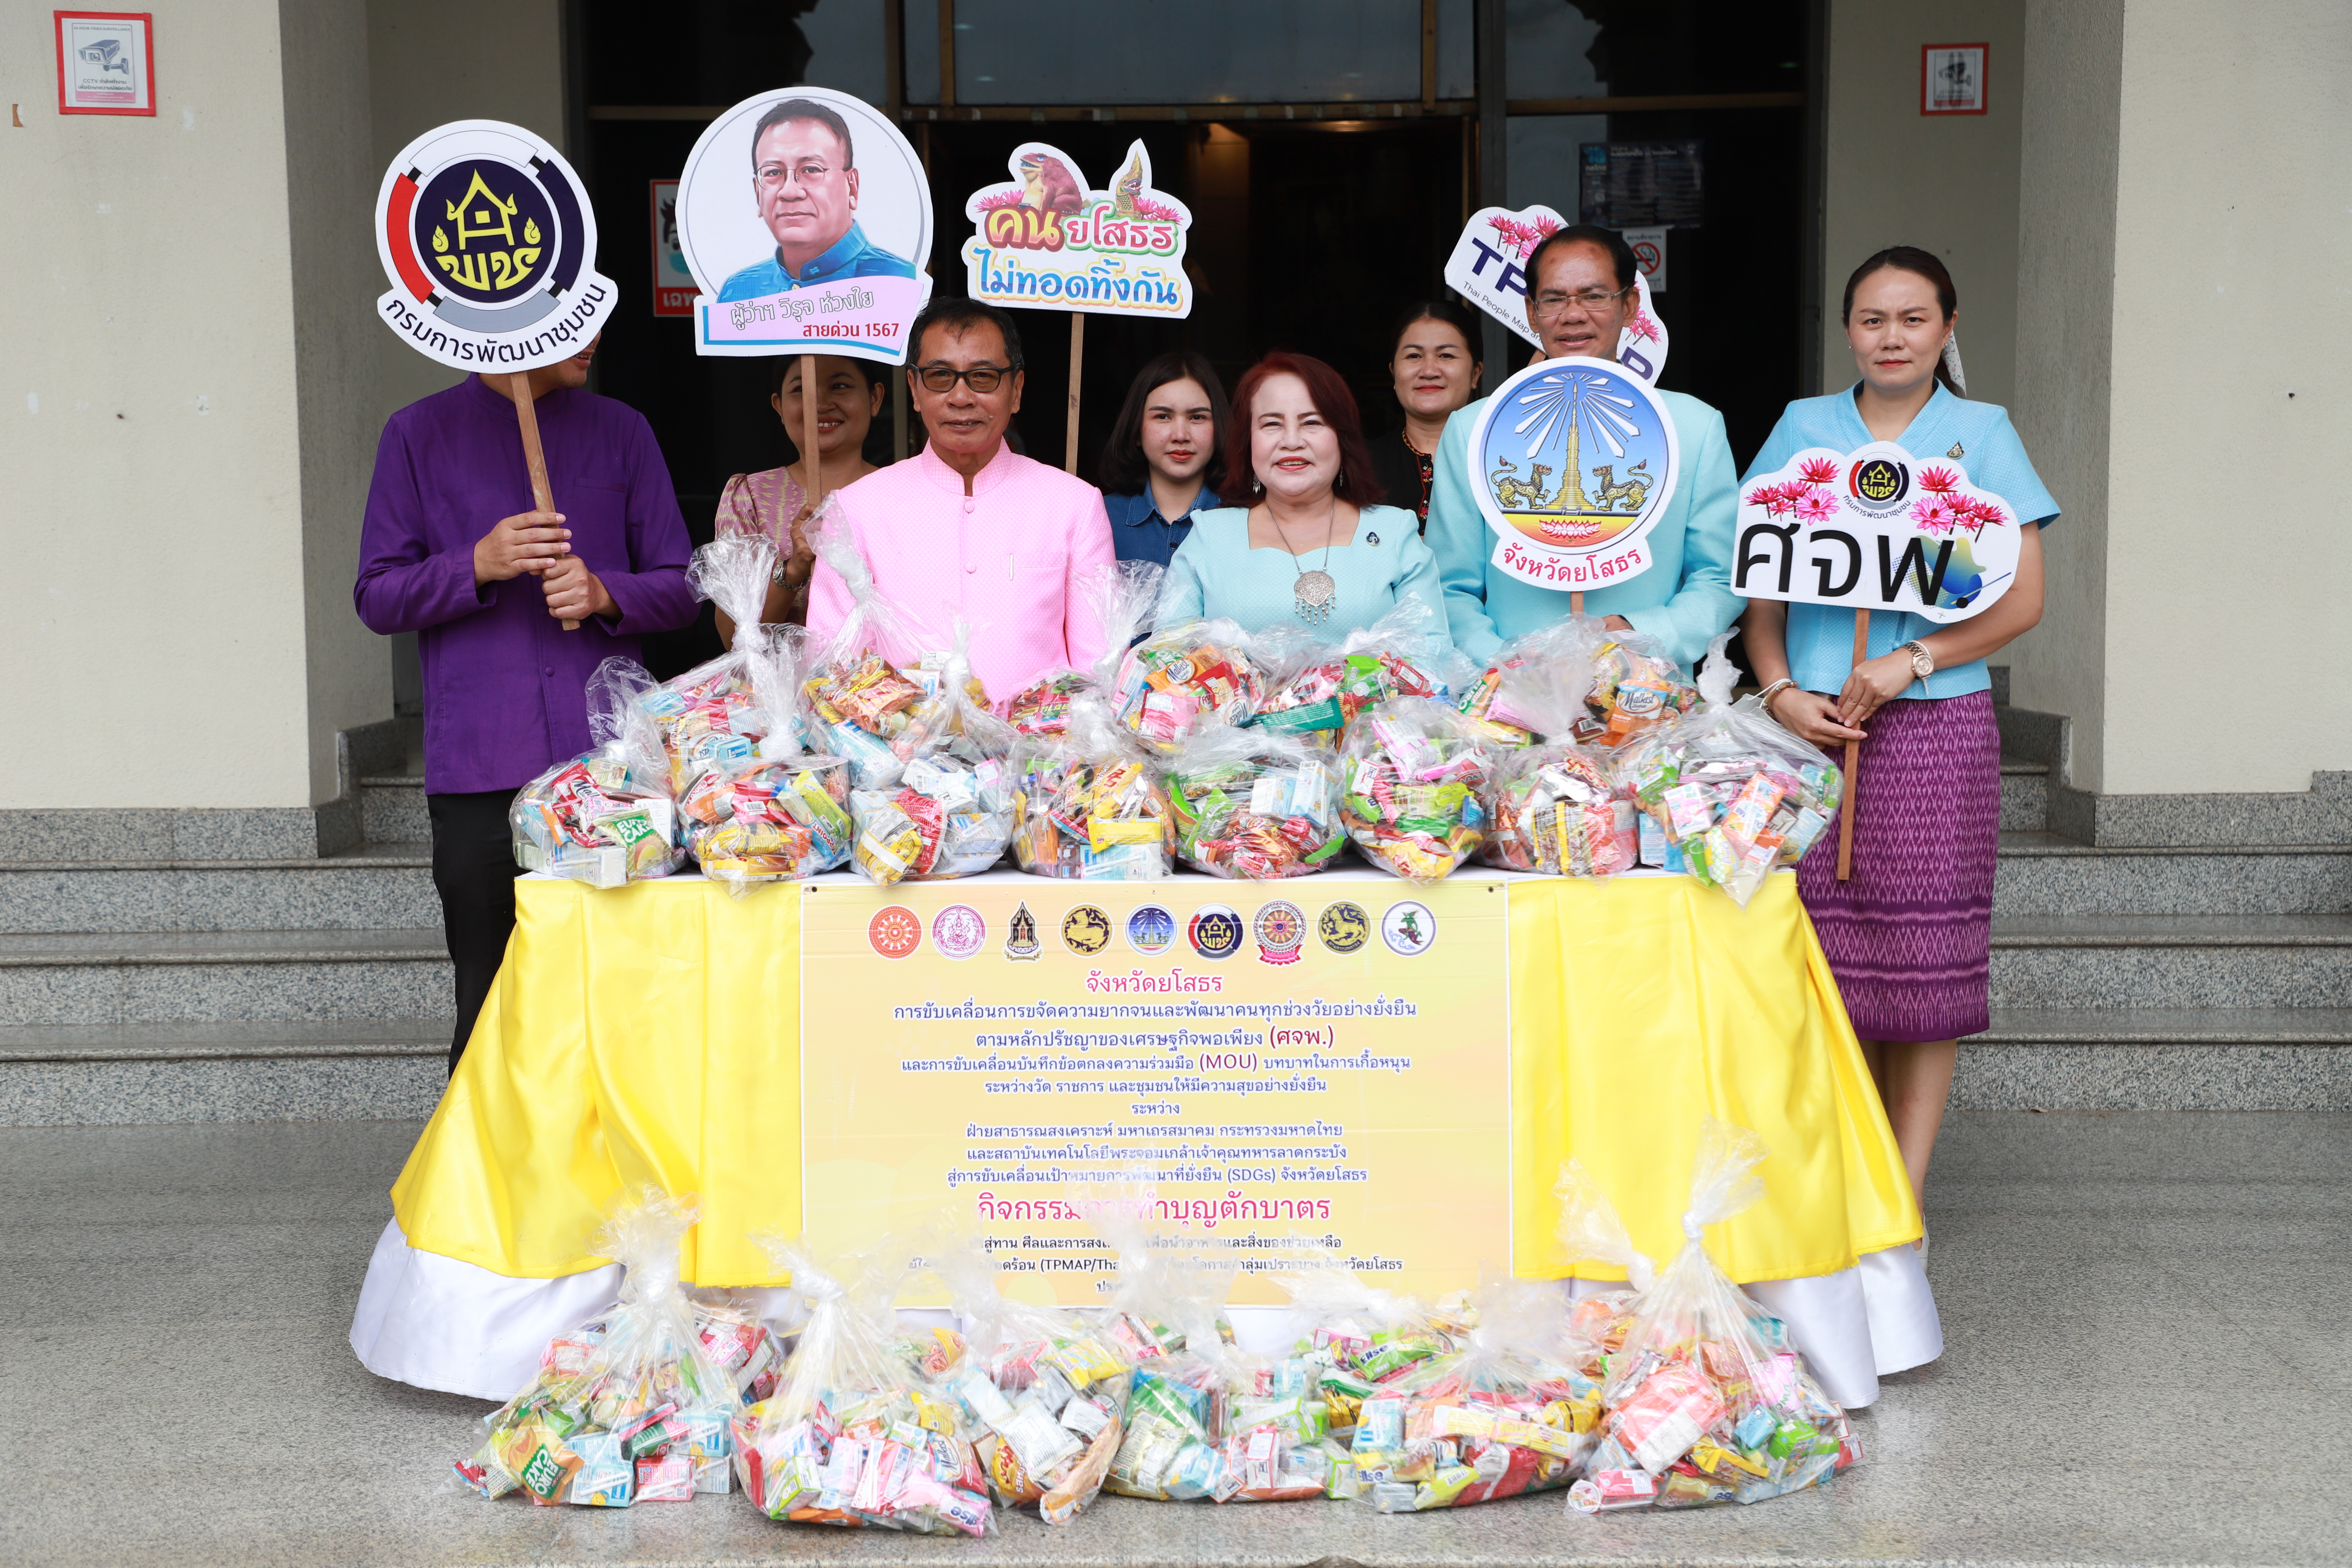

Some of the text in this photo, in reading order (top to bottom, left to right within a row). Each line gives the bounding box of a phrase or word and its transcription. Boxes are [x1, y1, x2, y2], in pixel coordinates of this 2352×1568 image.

[973, 247, 1178, 305] ไม่ทอดทิ้งกัน
[663, 292, 695, 308] เฉพ
[731, 286, 874, 331] ผู้ว่าฯ วิรุจ ห่วงใย
[385, 283, 606, 363] กรมการพัฒนาชุมชน
[1464, 281, 1543, 343] Thai People Map an
[803, 323, 900, 337] สายด่วน 1567
[1843, 495, 1911, 519] กรมการพัฒนาชุมชน
[1504, 542, 1642, 582] จังหวัดยโสธร
[1621, 691, 1655, 707] Malkist
[727, 744, 747, 759] Lactasoy
[1087, 969, 1222, 992] จังหวัดยโสธร
[895, 995, 1416, 1022] การขับเคลื่อนการขจัดความยากจนและพัฒนาคนทุกช่วงวัยอย่างยั่งยืน
[977, 1026, 1333, 1051] ตามหลักปรัชญาของเศรษฐกิจพอเพียง (ศจพ.)
[903, 1050, 1410, 1072] และการขับเคลื่อนบันทึกข้อตกลงความร่วมมือ (MOU) บทบาทในการเกื้อหนุน
[986, 1077, 1326, 1096] ระหว่างวัด ราชการ และชุมชนให้มีความสุขอย่างยั่งยืน
[1132, 1101, 1179, 1114] ระหว่าง
[968, 1121, 1341, 1136] ฝ่ายสาธารณสงเคราะห์ มหาเถรสมาคม กระทรวงมหาดไทย
[968, 1144, 1346, 1163] และสถาบันเทคโนโลยีพระจอมเกล้าเจ้าคุณทหารลาดกระบัง
[948, 1164, 1366, 1187] สู่การขับเคลื่อนเป้าหมายการพัฒนาที่ยั่งยืน (SDGs) จังหวัดยโสธร
[985, 1236, 1017, 1253] สู่ทาน
[1040, 1259, 1119, 1273] (TPMAP/Tha
[1360, 1344, 1388, 1366] Ellse
[525, 1449, 548, 1487] CAKE
[534, 1458, 559, 1495] EURO
